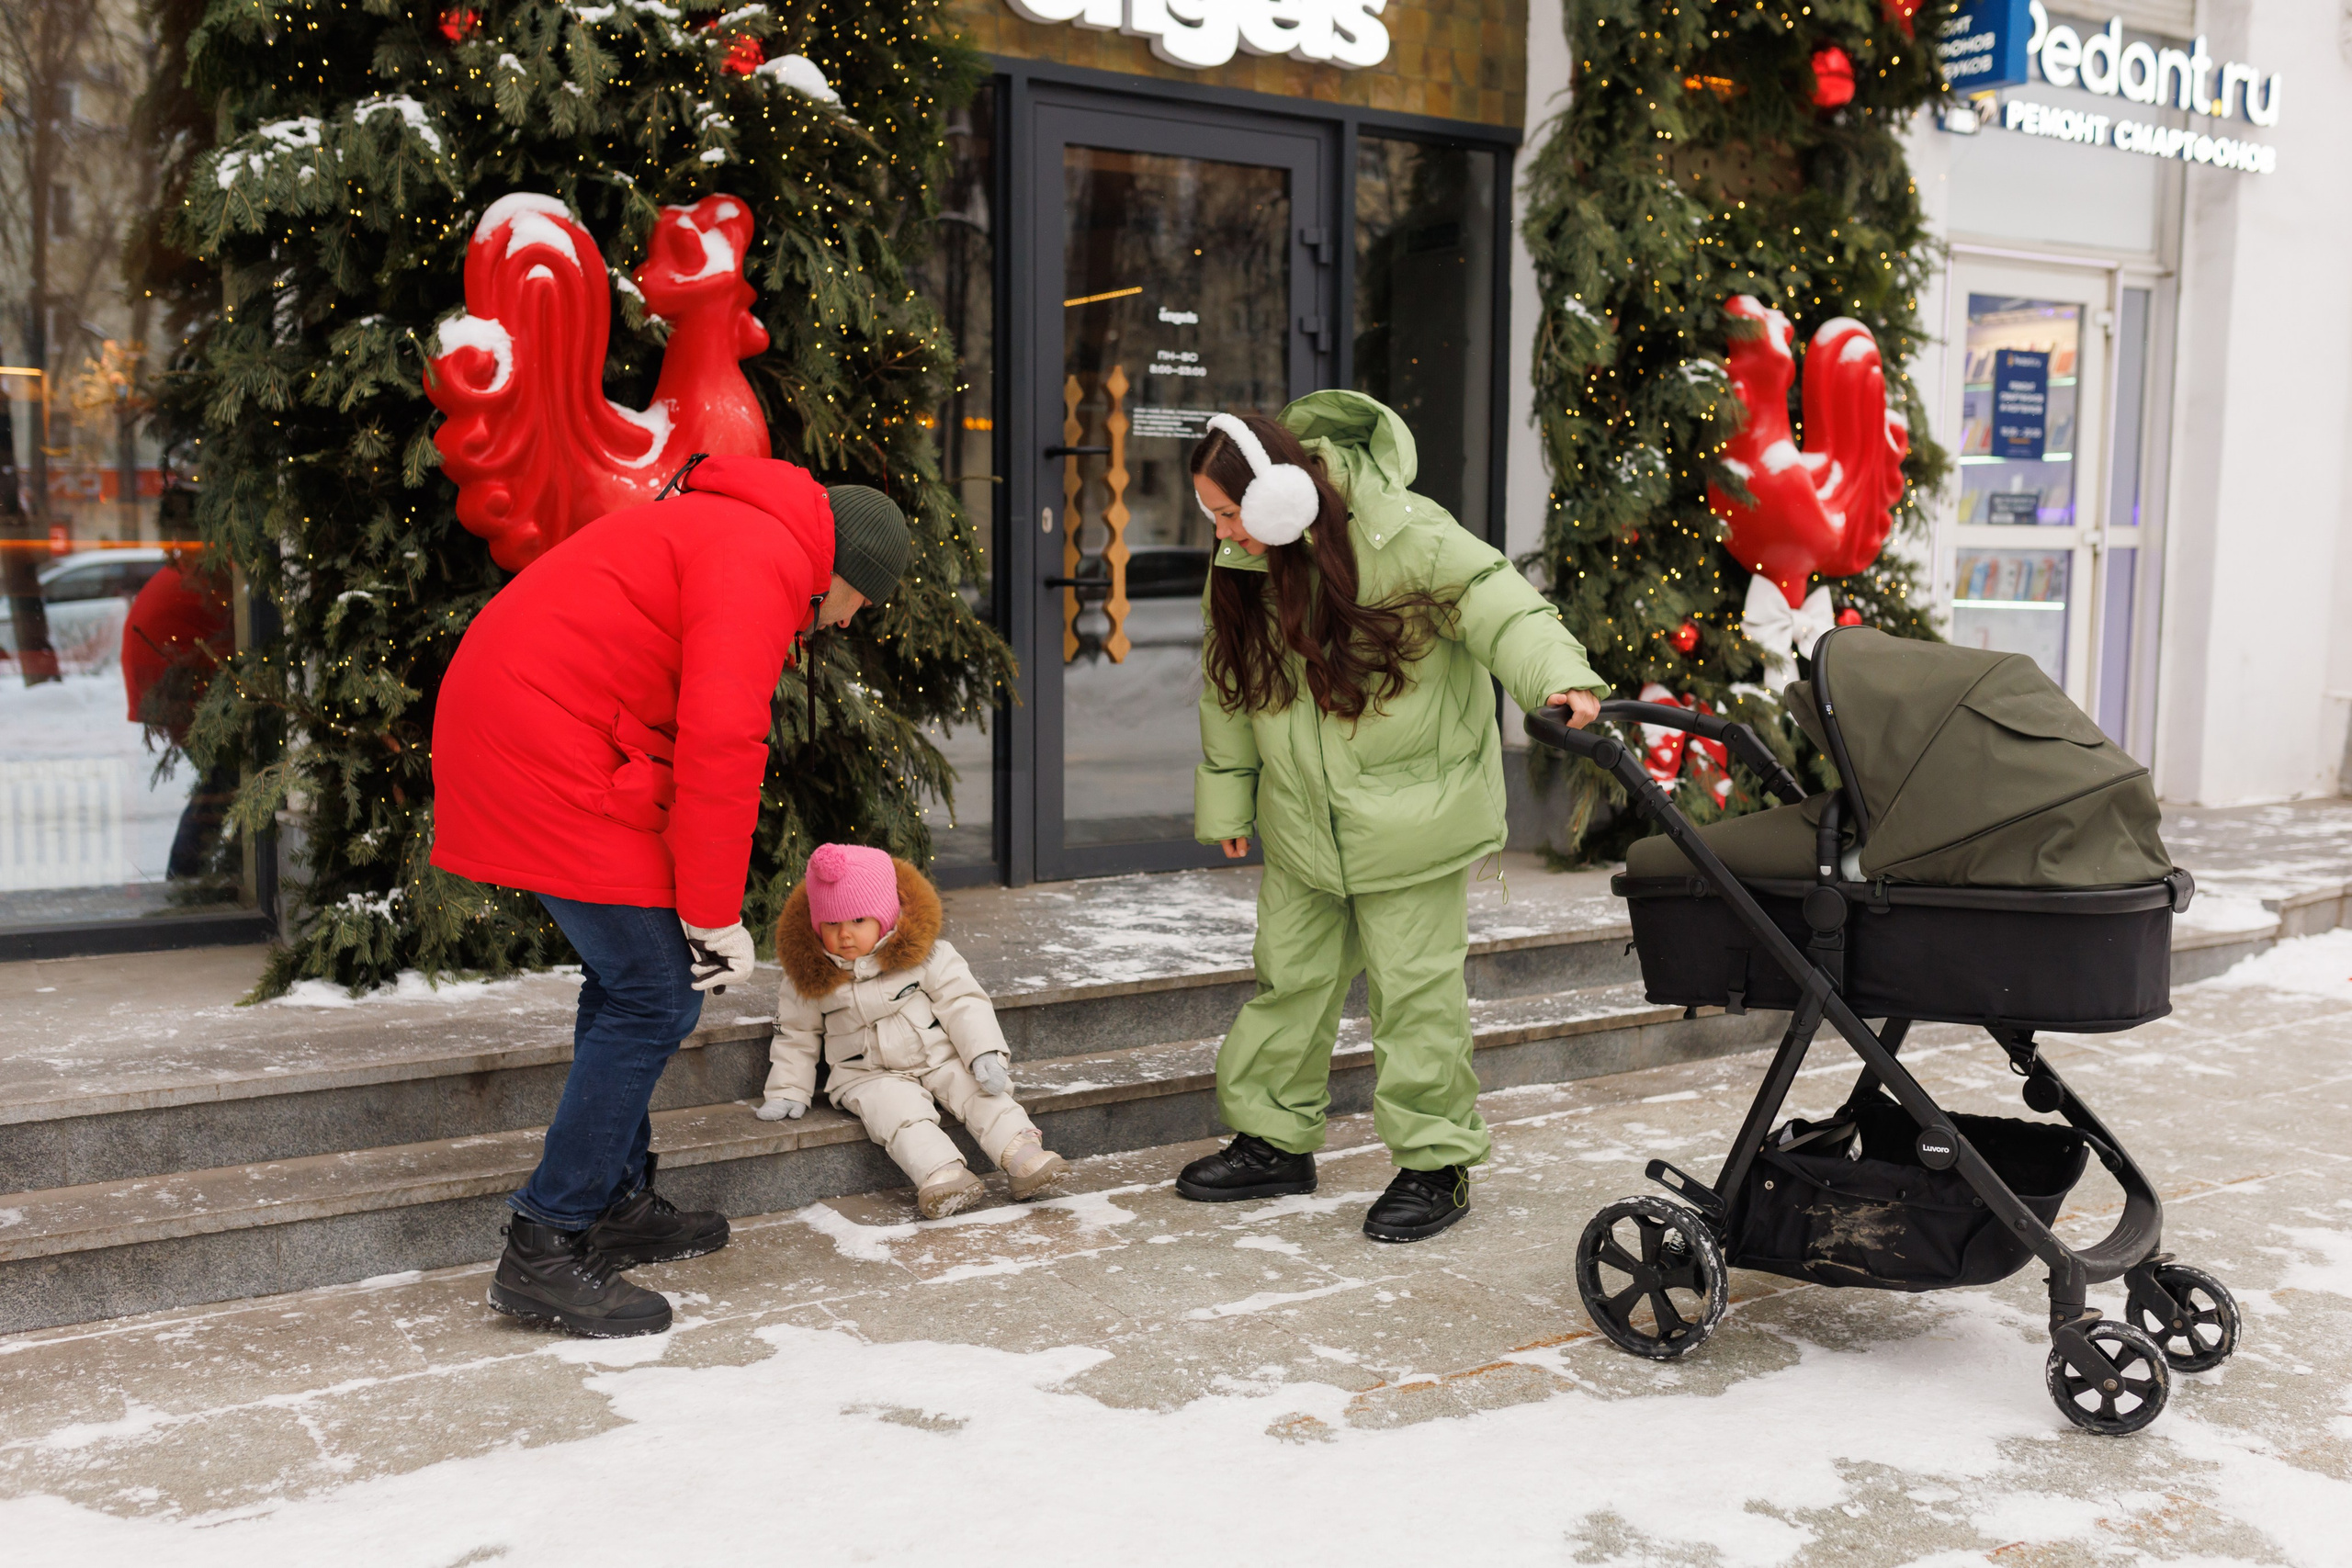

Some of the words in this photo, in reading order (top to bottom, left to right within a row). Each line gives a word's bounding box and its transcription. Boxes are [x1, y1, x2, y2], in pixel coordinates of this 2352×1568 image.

[1937, 15, 1973, 38] ОНТ
[1935, 31, 1996, 58] ФОНОВ
[1940, 54, 1993, 81] БУКОВ
[2006, 99, 2109, 146] РЕМОНТ
[2113, 119, 2277, 175] СМАРТФОНОВ
[1922, 1144, 1950, 1154] Luvoro
